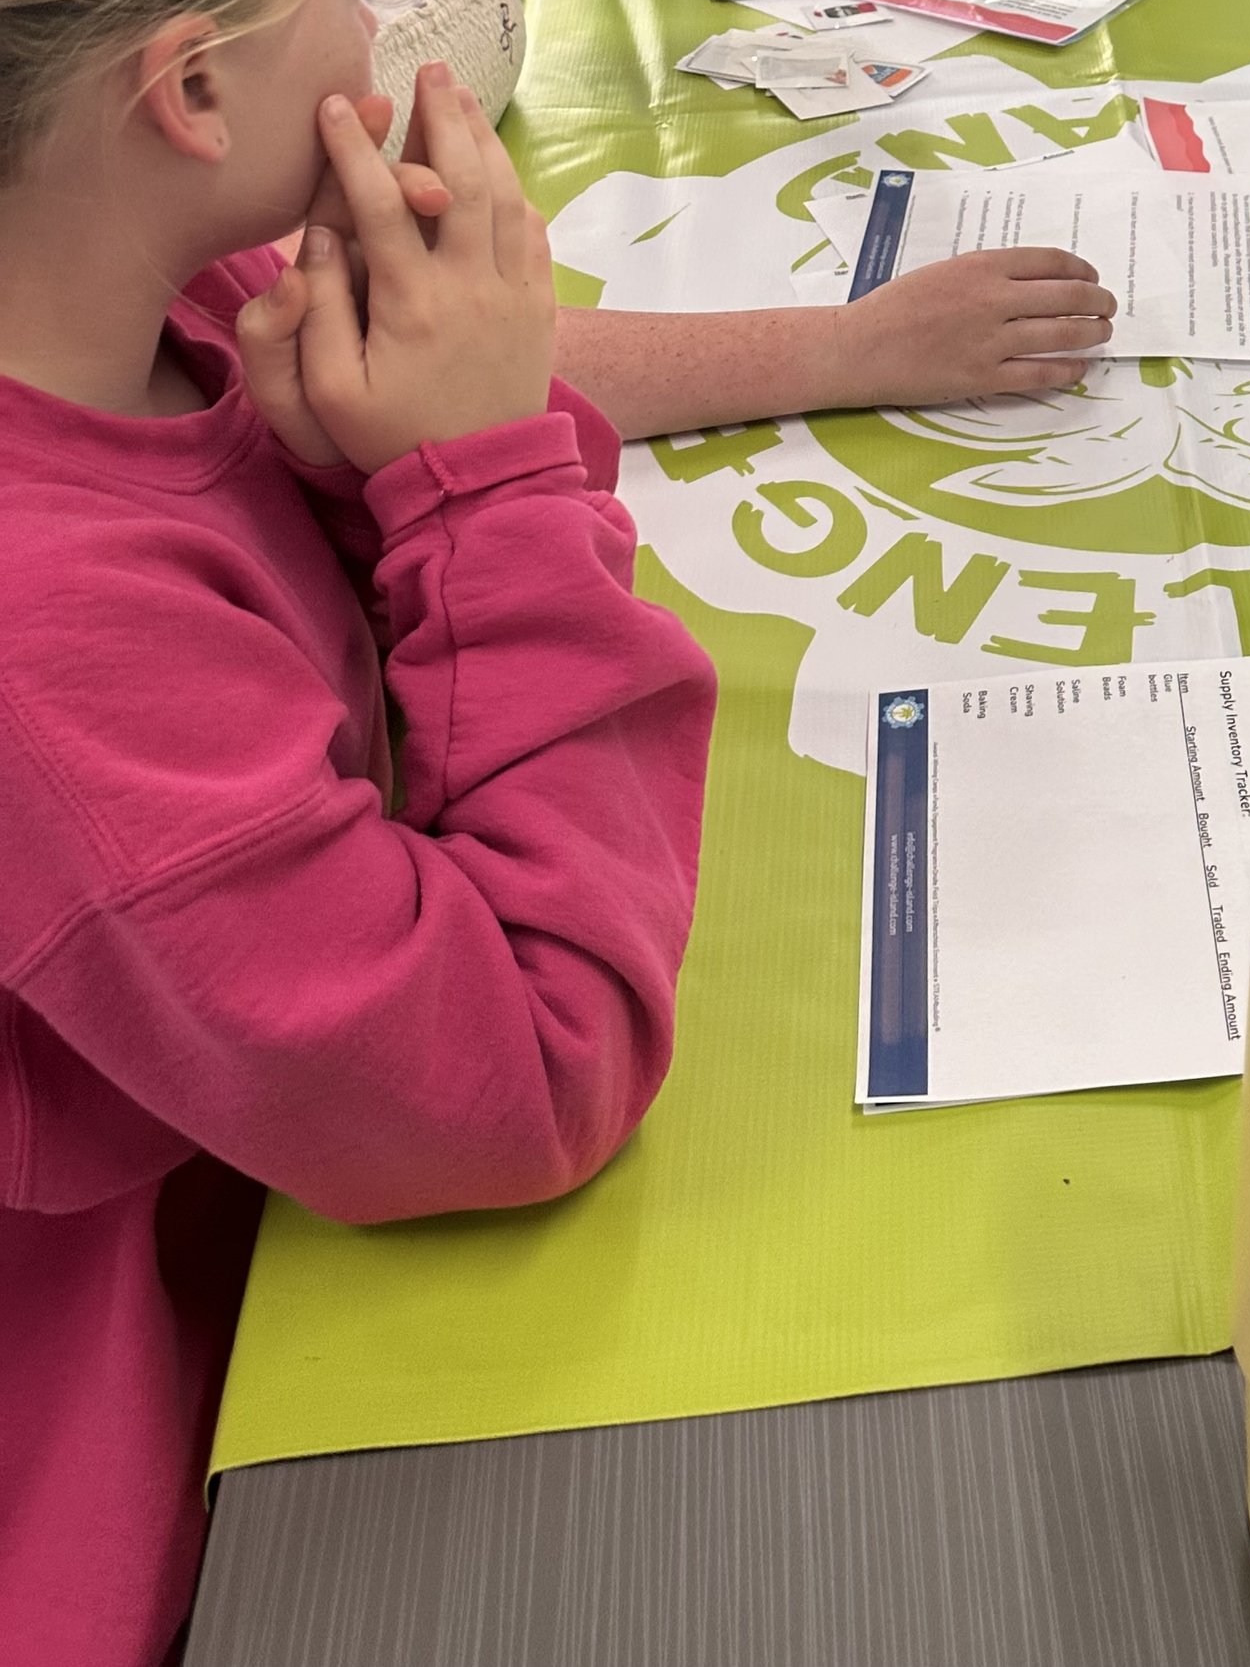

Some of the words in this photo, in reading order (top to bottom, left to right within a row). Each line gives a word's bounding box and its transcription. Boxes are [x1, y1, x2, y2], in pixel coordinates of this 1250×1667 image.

[1056, 681, 1065, 714] Solution
[1071, 679, 1081, 704] Saline
[1102, 676, 1111, 701] Beads
[1117, 675, 1127, 697] Foam
[1148, 674, 1158, 703] bottles
[1163, 673, 1173, 693] Glue
[1179, 673, 1189, 694] Item
[1219, 670, 1233, 711] Supply
[962, 692, 971, 714] Soda
[977, 690, 987, 719] Baking
[1009, 686, 1018, 714] Cream
[1024, 684, 1034, 717] Shaving
[1186, 725, 1198, 764] Starting
[1225, 713, 1243, 768] Inventory
[1192, 766, 1206, 802] Amount
[1198, 812, 1213, 848] Bought
[1205, 864, 1220, 889] Sold
[1212, 905, 1228, 943] Traded
[1219, 951, 1234, 991] Ending
[1225, 993, 1242, 1041] Amount
